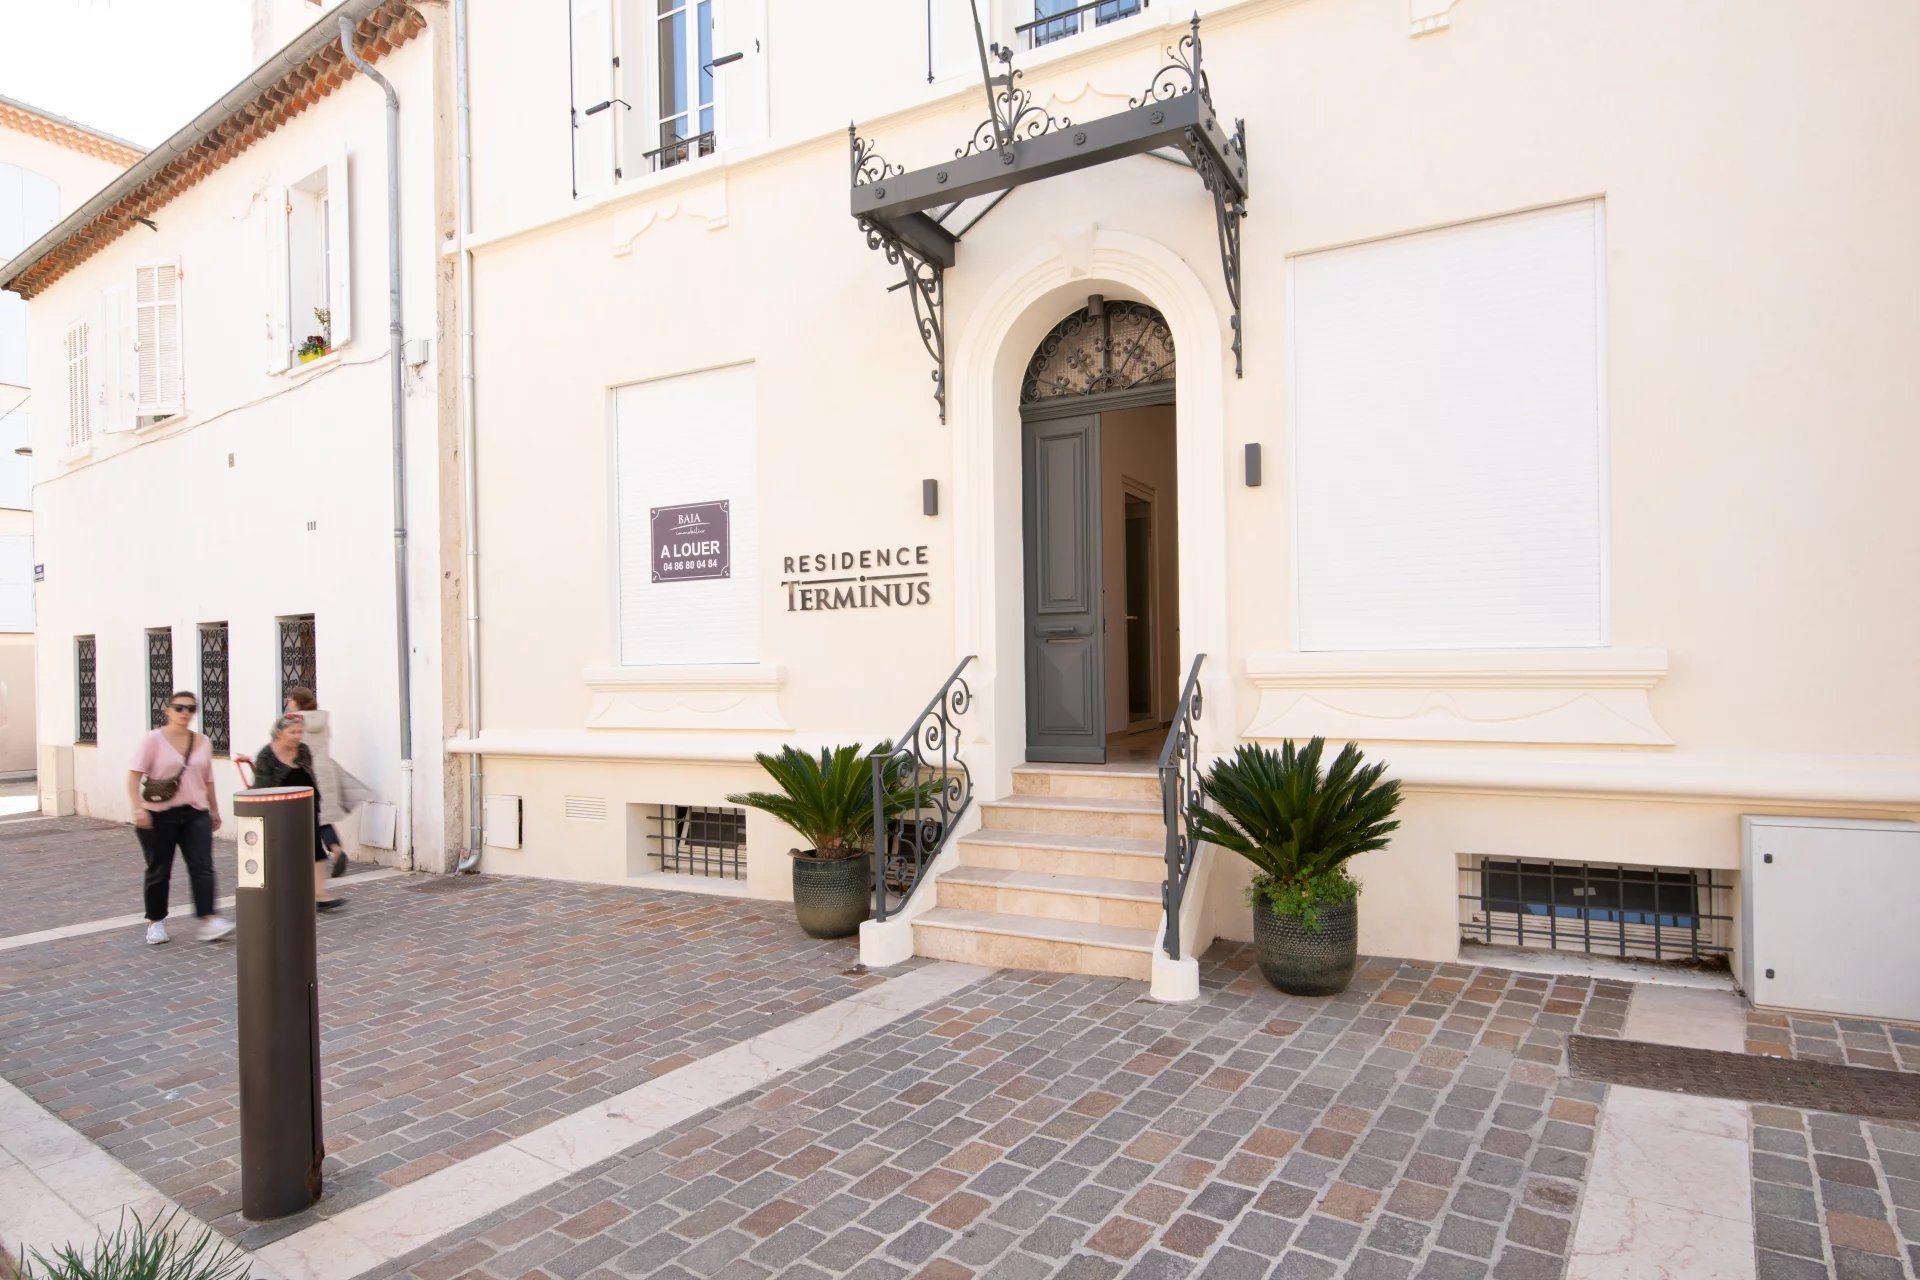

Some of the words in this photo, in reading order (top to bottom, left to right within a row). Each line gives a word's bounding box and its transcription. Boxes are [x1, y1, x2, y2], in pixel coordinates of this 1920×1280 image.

[678, 513, 701, 525] BAIA
[660, 544, 671, 559] A
[673, 540, 720, 558] LOUER
[663, 562, 673, 571] 04
[674, 561, 684, 570] 86
[685, 560, 695, 570] 80
[696, 559, 706, 569] 04
[707, 558, 718, 568] 84
[783, 545, 928, 574] RESIDENCE
[781, 580, 930, 612] TERMINUS
